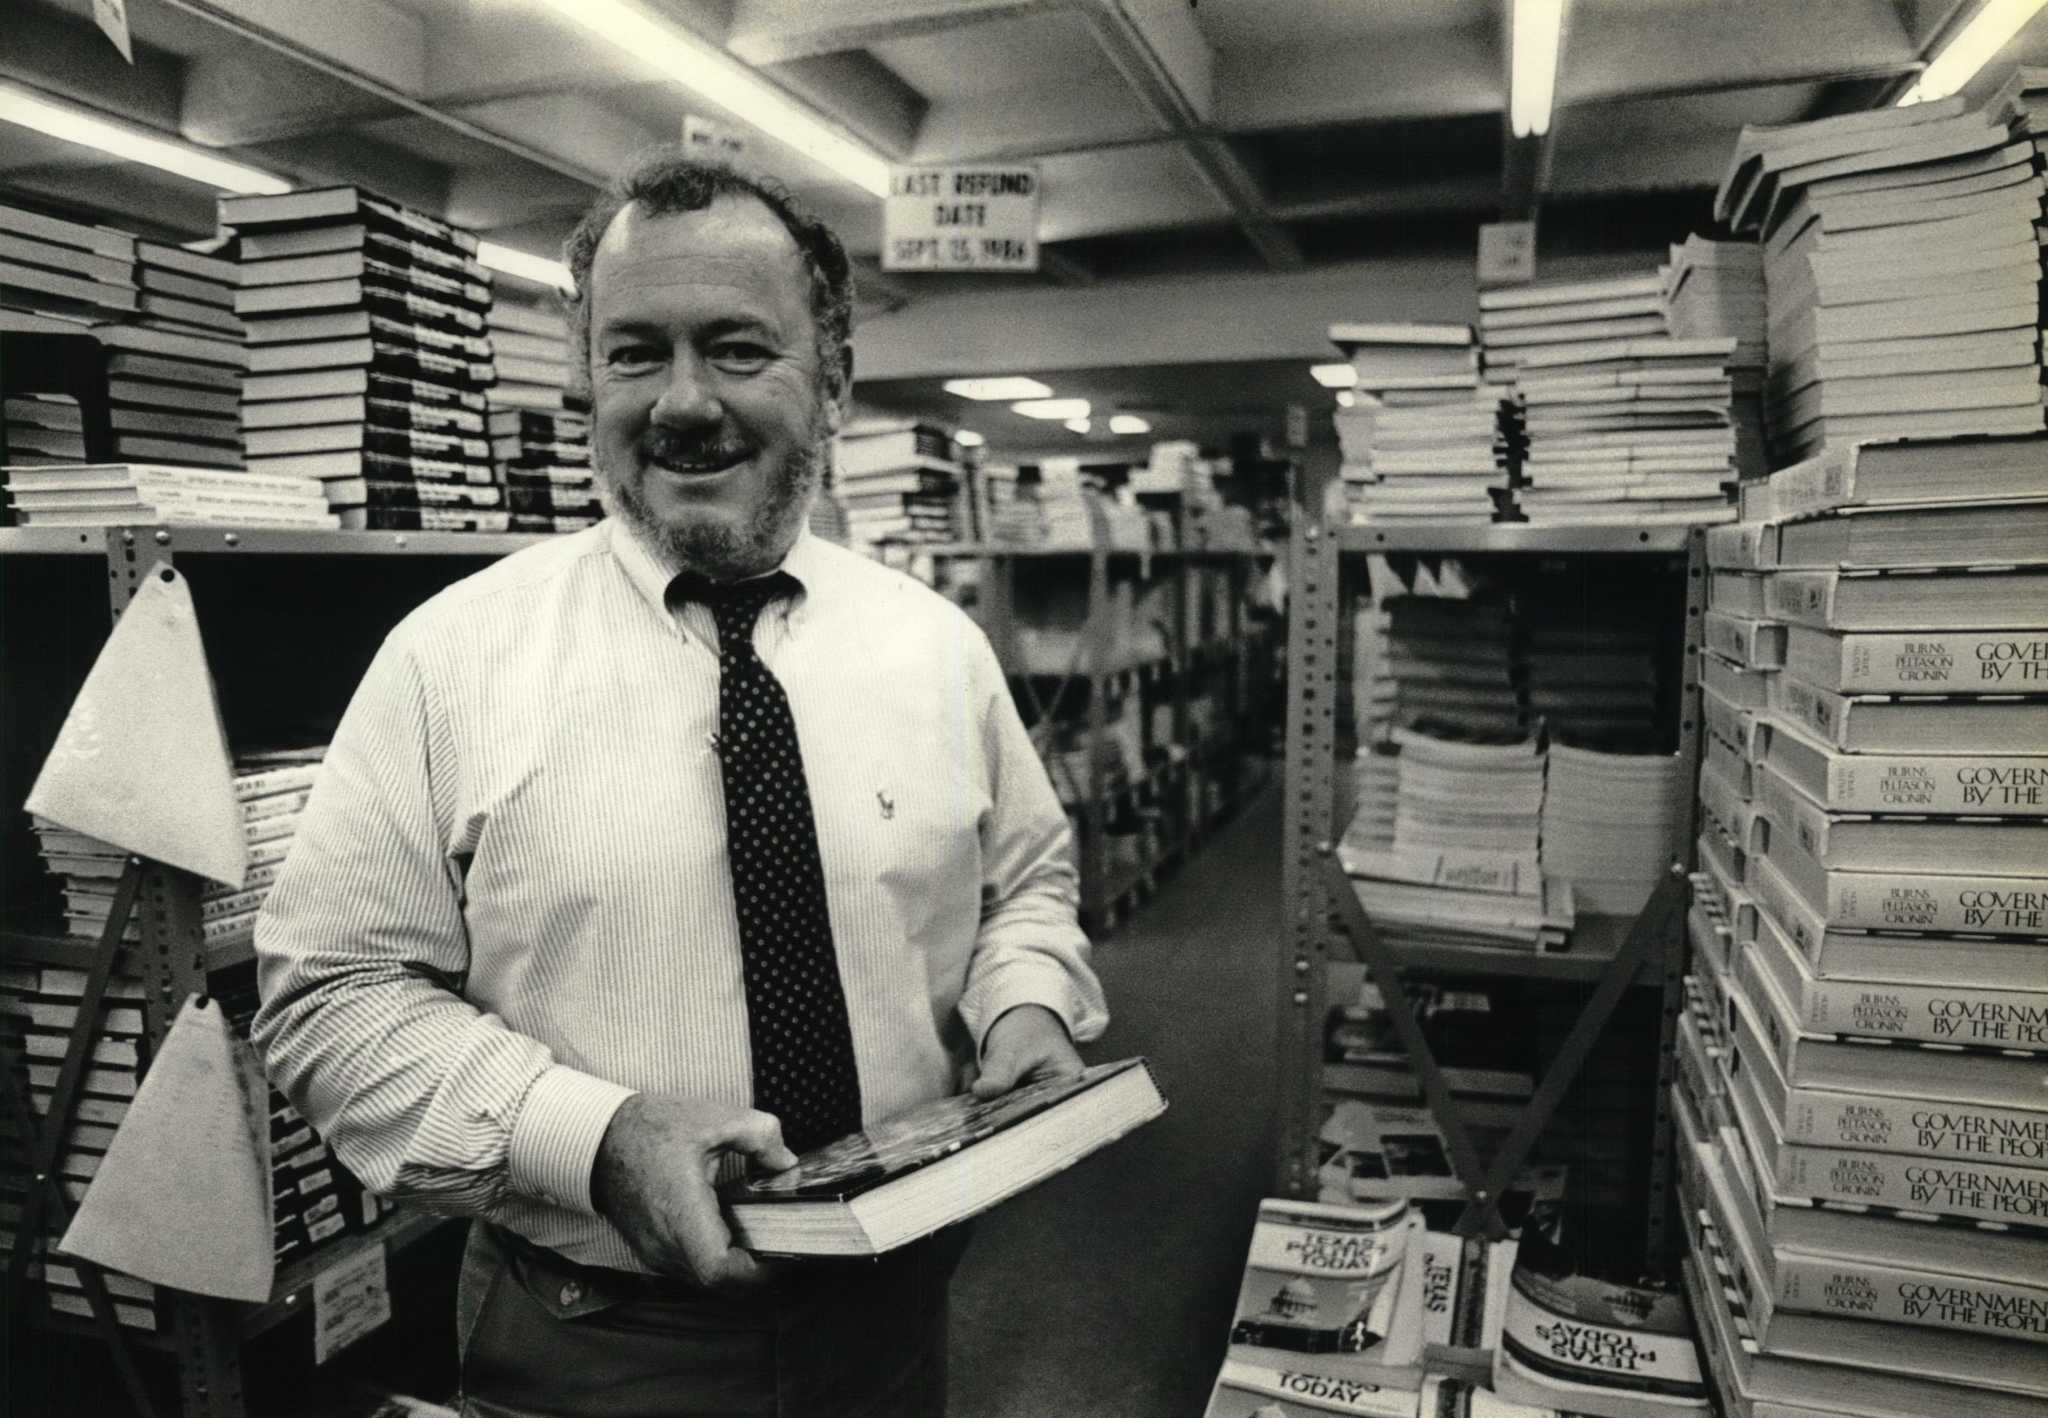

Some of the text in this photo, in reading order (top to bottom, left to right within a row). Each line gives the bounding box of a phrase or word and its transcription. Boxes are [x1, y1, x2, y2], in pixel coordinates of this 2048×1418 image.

[892, 173, 1034, 196] LAST REFUND
[935, 204, 986, 227] DATE
[1905, 642, 1945, 654] BURNS
[1896, 656, 1953, 668] PELTASON
[1899, 671, 1949, 681] CRONIN
[1982, 661, 2012, 682] BY
[1888, 767, 1928, 777] BURNS
[1880, 779, 1936, 791] PELTASON
[1883, 793, 1932, 804] CRONIN
[1963, 786, 2043, 806] BY THE
[1890, 888, 1930, 899] BURNS
[1882, 899, 1938, 912] PELTASON
[1885, 914, 1933, 924] CRONIN
[1964, 909, 2044, 928] BY THE
[1861, 994, 1900, 1005] BURNS
[1853, 1006, 1908, 1019] PELTASON
[1856, 1020, 1904, 1032] CRONIN
[1934, 1018, 1962, 1037] BY
[1968, 1020, 2009, 1040] THE
[1846, 1105, 1883, 1117] BURNS
[1838, 1116, 1892, 1132] PELTASON
[1840, 1132, 1887, 1143] CRONIN
[1918, 1129, 1945, 1149] BY
[1948, 1132, 1992, 1153] THE
[1839, 1159, 1877, 1171] BURNS
[1830, 1169, 1885, 1185] PELTASON
[1833, 1184, 1880, 1196] CRONIN
[1911, 1184, 1938, 1205] BY
[1944, 1187, 1986, 1209] THE
[1303, 1233, 1375, 1248] TEXAS
[1302, 1254, 1371, 1269] TODAY
[1832, 1274, 1870, 1287] BURNS
[1824, 1283, 1878, 1301] PELTASON
[1826, 1299, 1873, 1312] CRONIN
[1903, 1300, 1931, 1319] BY
[1937, 1303, 1977, 1324] THE
[1552, 1321, 1640, 1348] TODAY
[1551, 1343, 1642, 1372] TEXAS
[1278, 1369, 1363, 1404] TODAY
